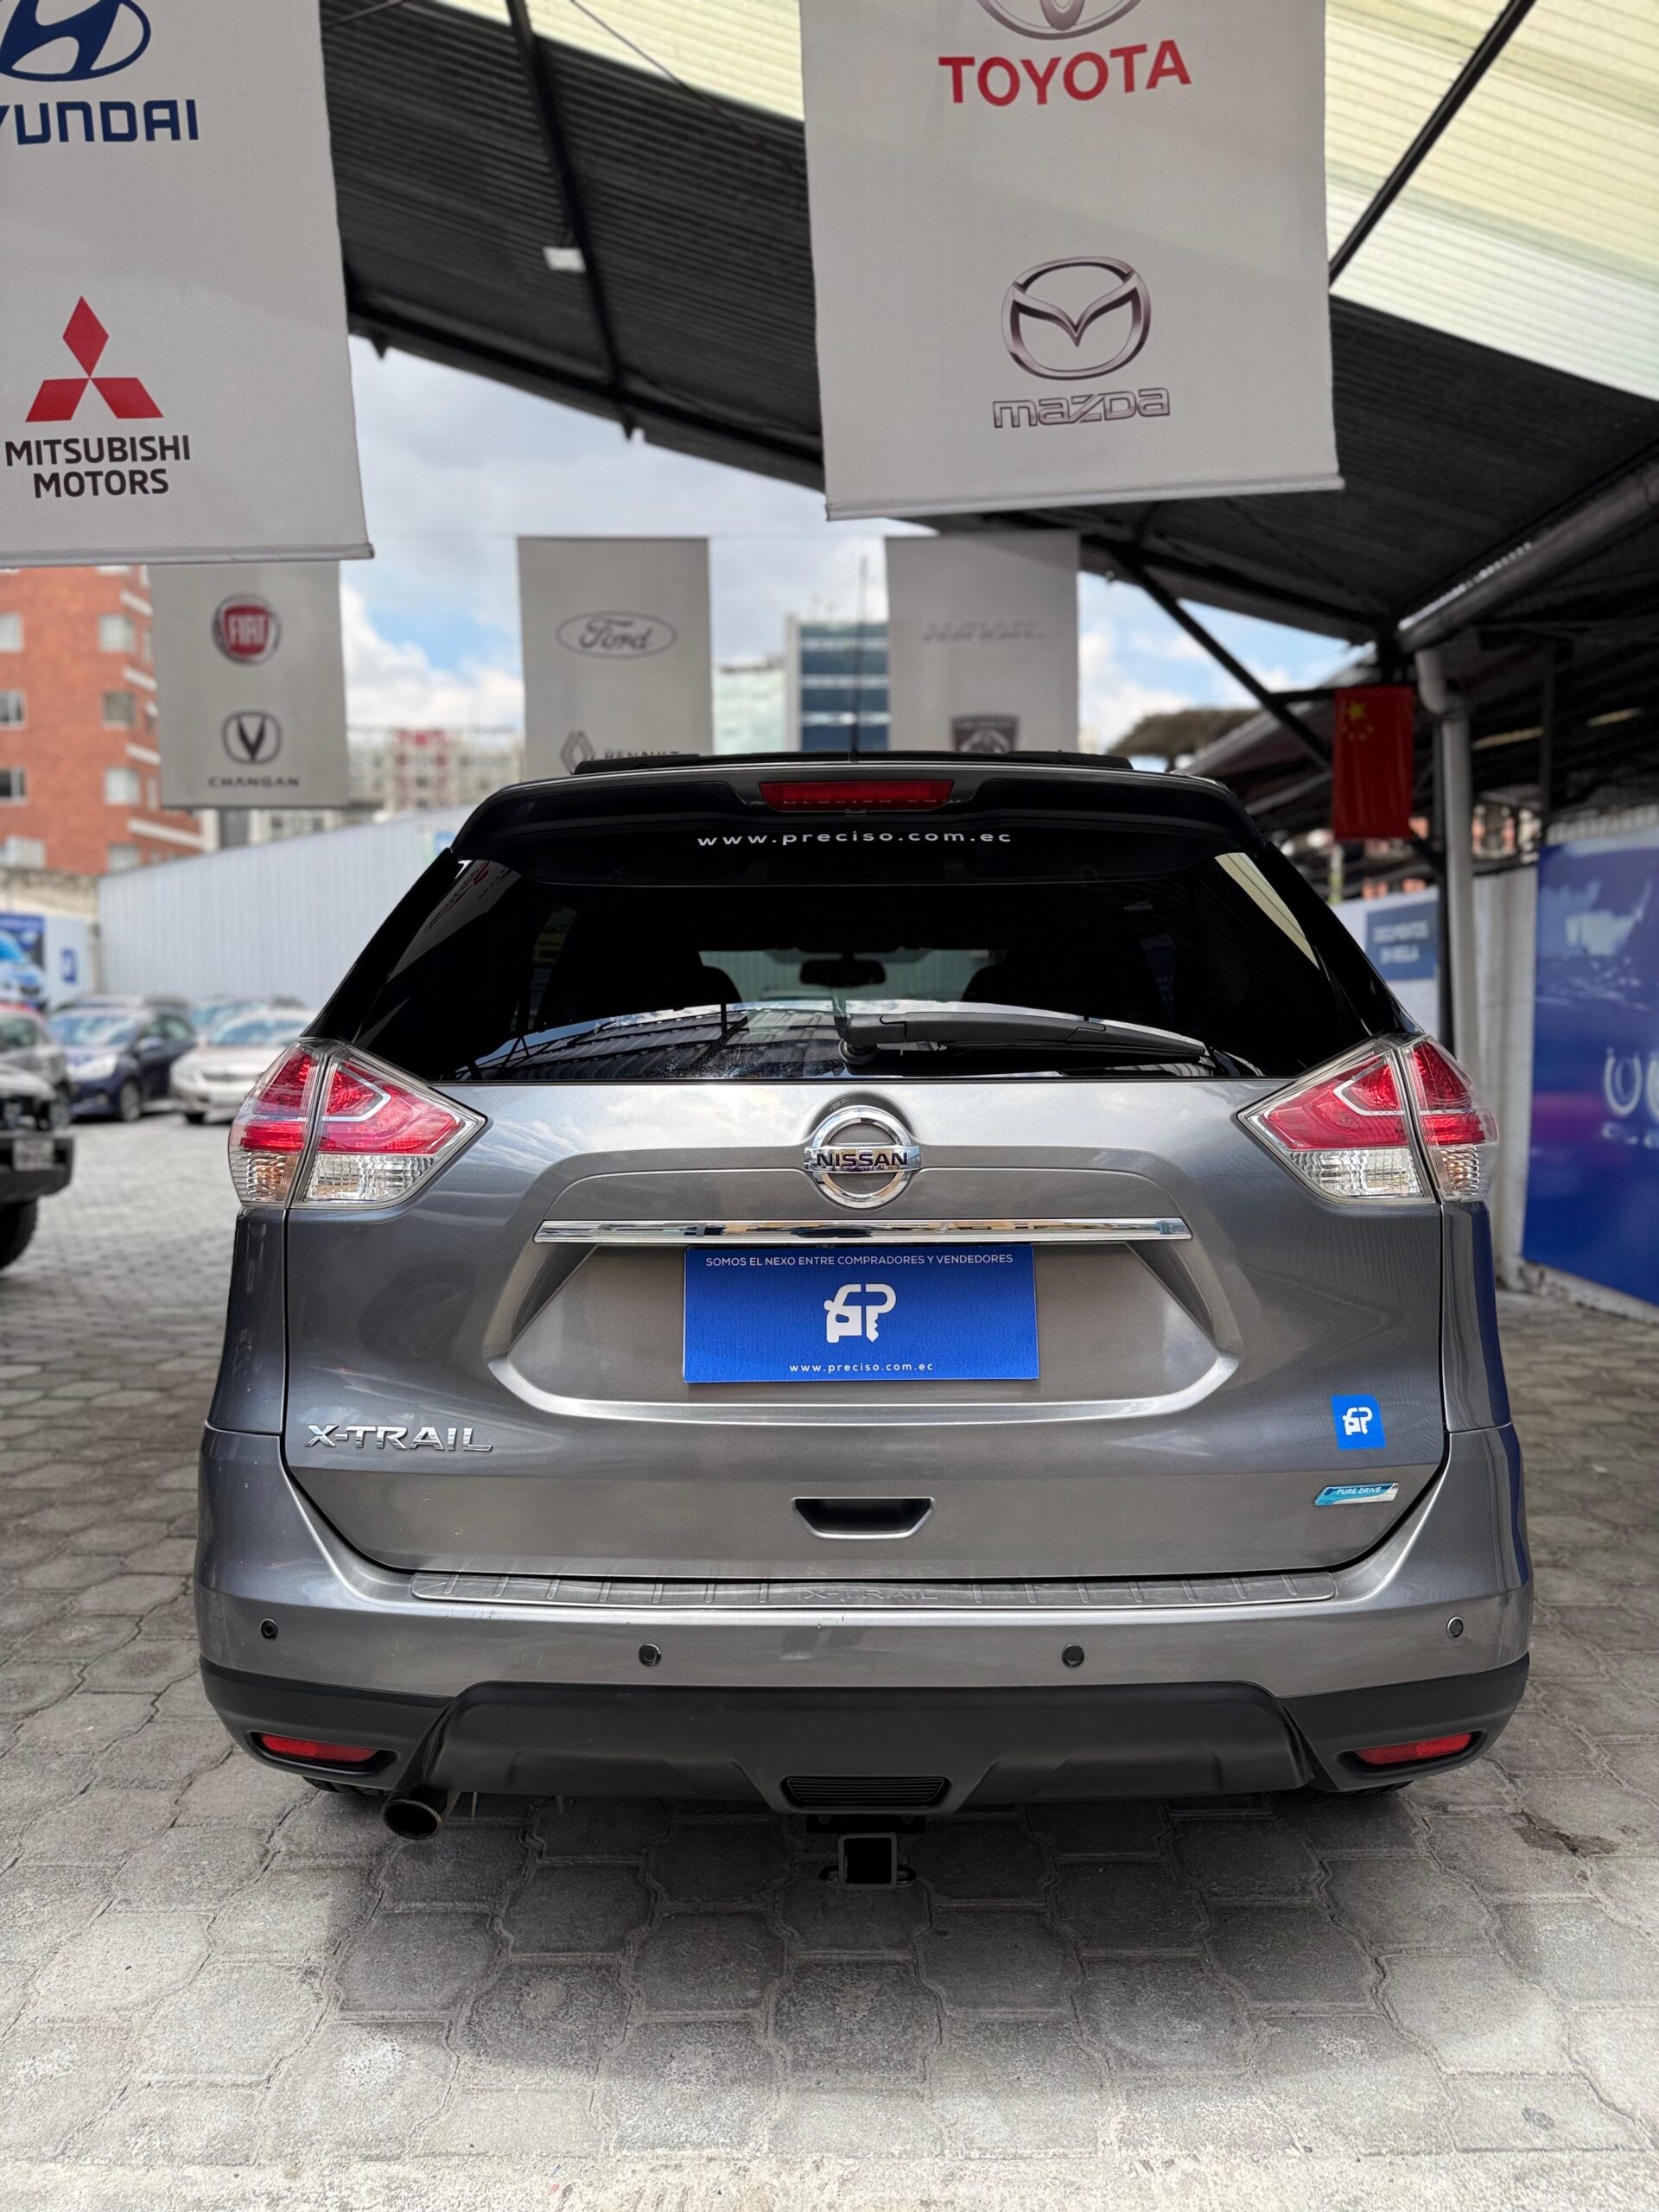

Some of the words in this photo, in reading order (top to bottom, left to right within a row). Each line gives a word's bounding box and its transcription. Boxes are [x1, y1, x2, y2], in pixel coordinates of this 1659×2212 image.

[938, 40, 1192, 106] TOYOTA
[5, 435, 190, 467] MITSUBISHI
[34, 469, 168, 499] MOTORS
[579, 618, 653, 650] Ford
[209, 777, 300, 787] CHANGAN
[697, 830, 1011, 846] www.preciso.com.ec
[817, 1152, 908, 1166] NISSAN
[705, 1257, 747, 1267] SOMOS
[749, 1257, 763, 1266] EL
[765, 1256, 796, 1266] NEXO
[798, 1256, 835, 1266] ENTRE
[837, 1255, 925, 1265] COMPRADORES
[926, 1255, 934, 1264] Y
[936, 1254, 1014, 1264] VENDEDORES
[789, 1362, 934, 1374] www.preciso.com.ec
[304, 1424, 493, 1452] X-TRAIL
[804, 1588, 939, 1599] X-TRAIL
